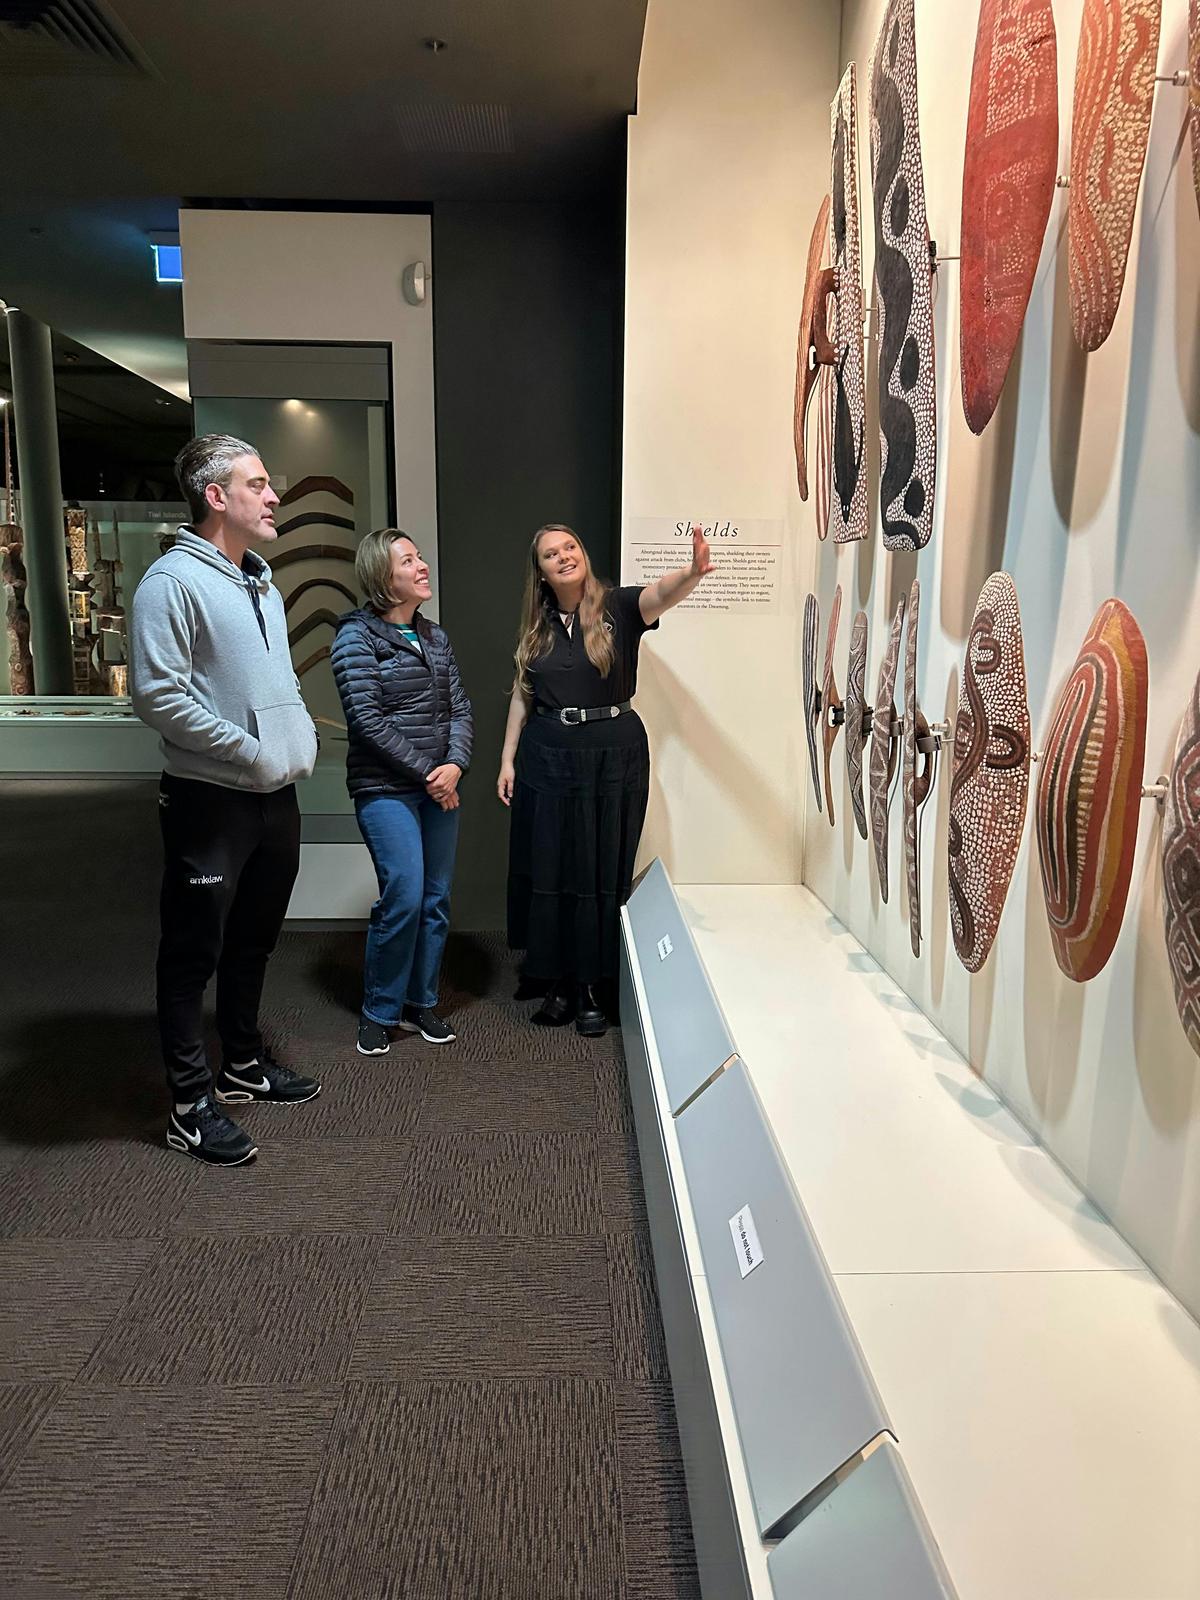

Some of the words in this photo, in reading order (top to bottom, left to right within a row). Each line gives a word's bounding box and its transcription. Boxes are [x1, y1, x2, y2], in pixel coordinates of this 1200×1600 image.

[674, 522, 739, 537] Shelds
[741, 1231, 746, 1239] do
[745, 1248, 754, 1266] touch
